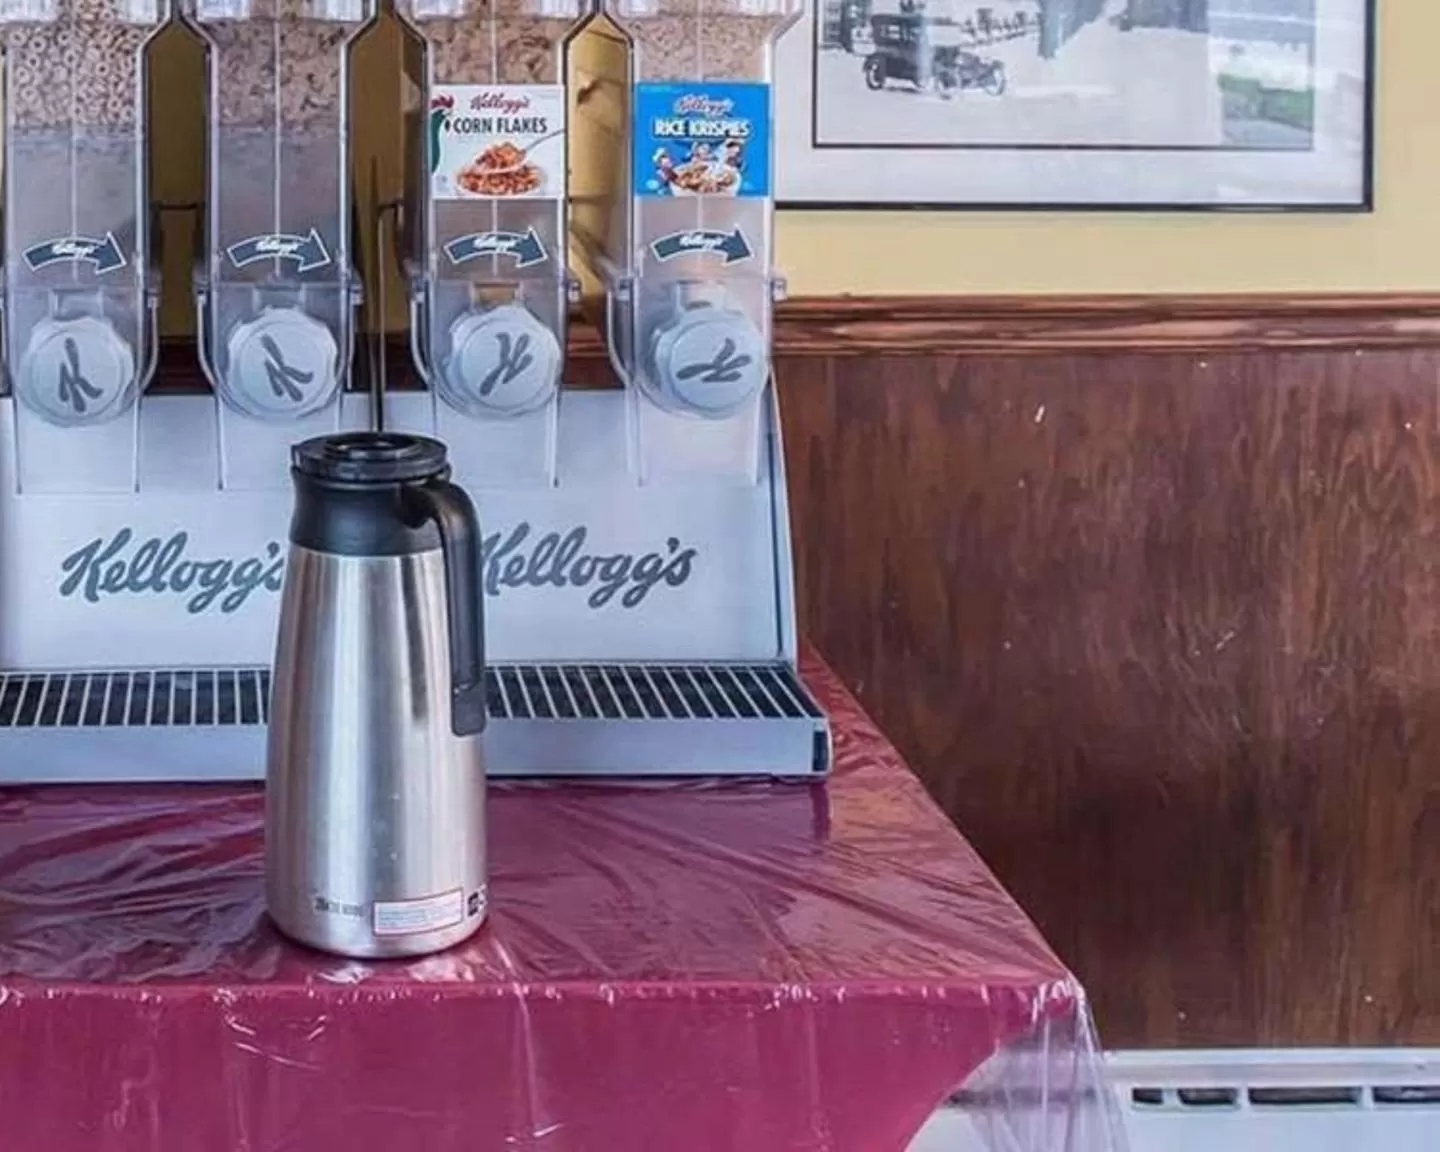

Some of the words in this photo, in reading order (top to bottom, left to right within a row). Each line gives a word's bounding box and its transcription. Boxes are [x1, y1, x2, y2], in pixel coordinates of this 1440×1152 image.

[470, 92, 531, 115] Kellogg's
[452, 116, 493, 134] CORN
[496, 116, 549, 134] FLAKES
[654, 119, 686, 136] RICE
[688, 119, 751, 136] KRISPIES
[59, 527, 284, 614] Kellogg's
[482, 521, 697, 609] Kellogg's
